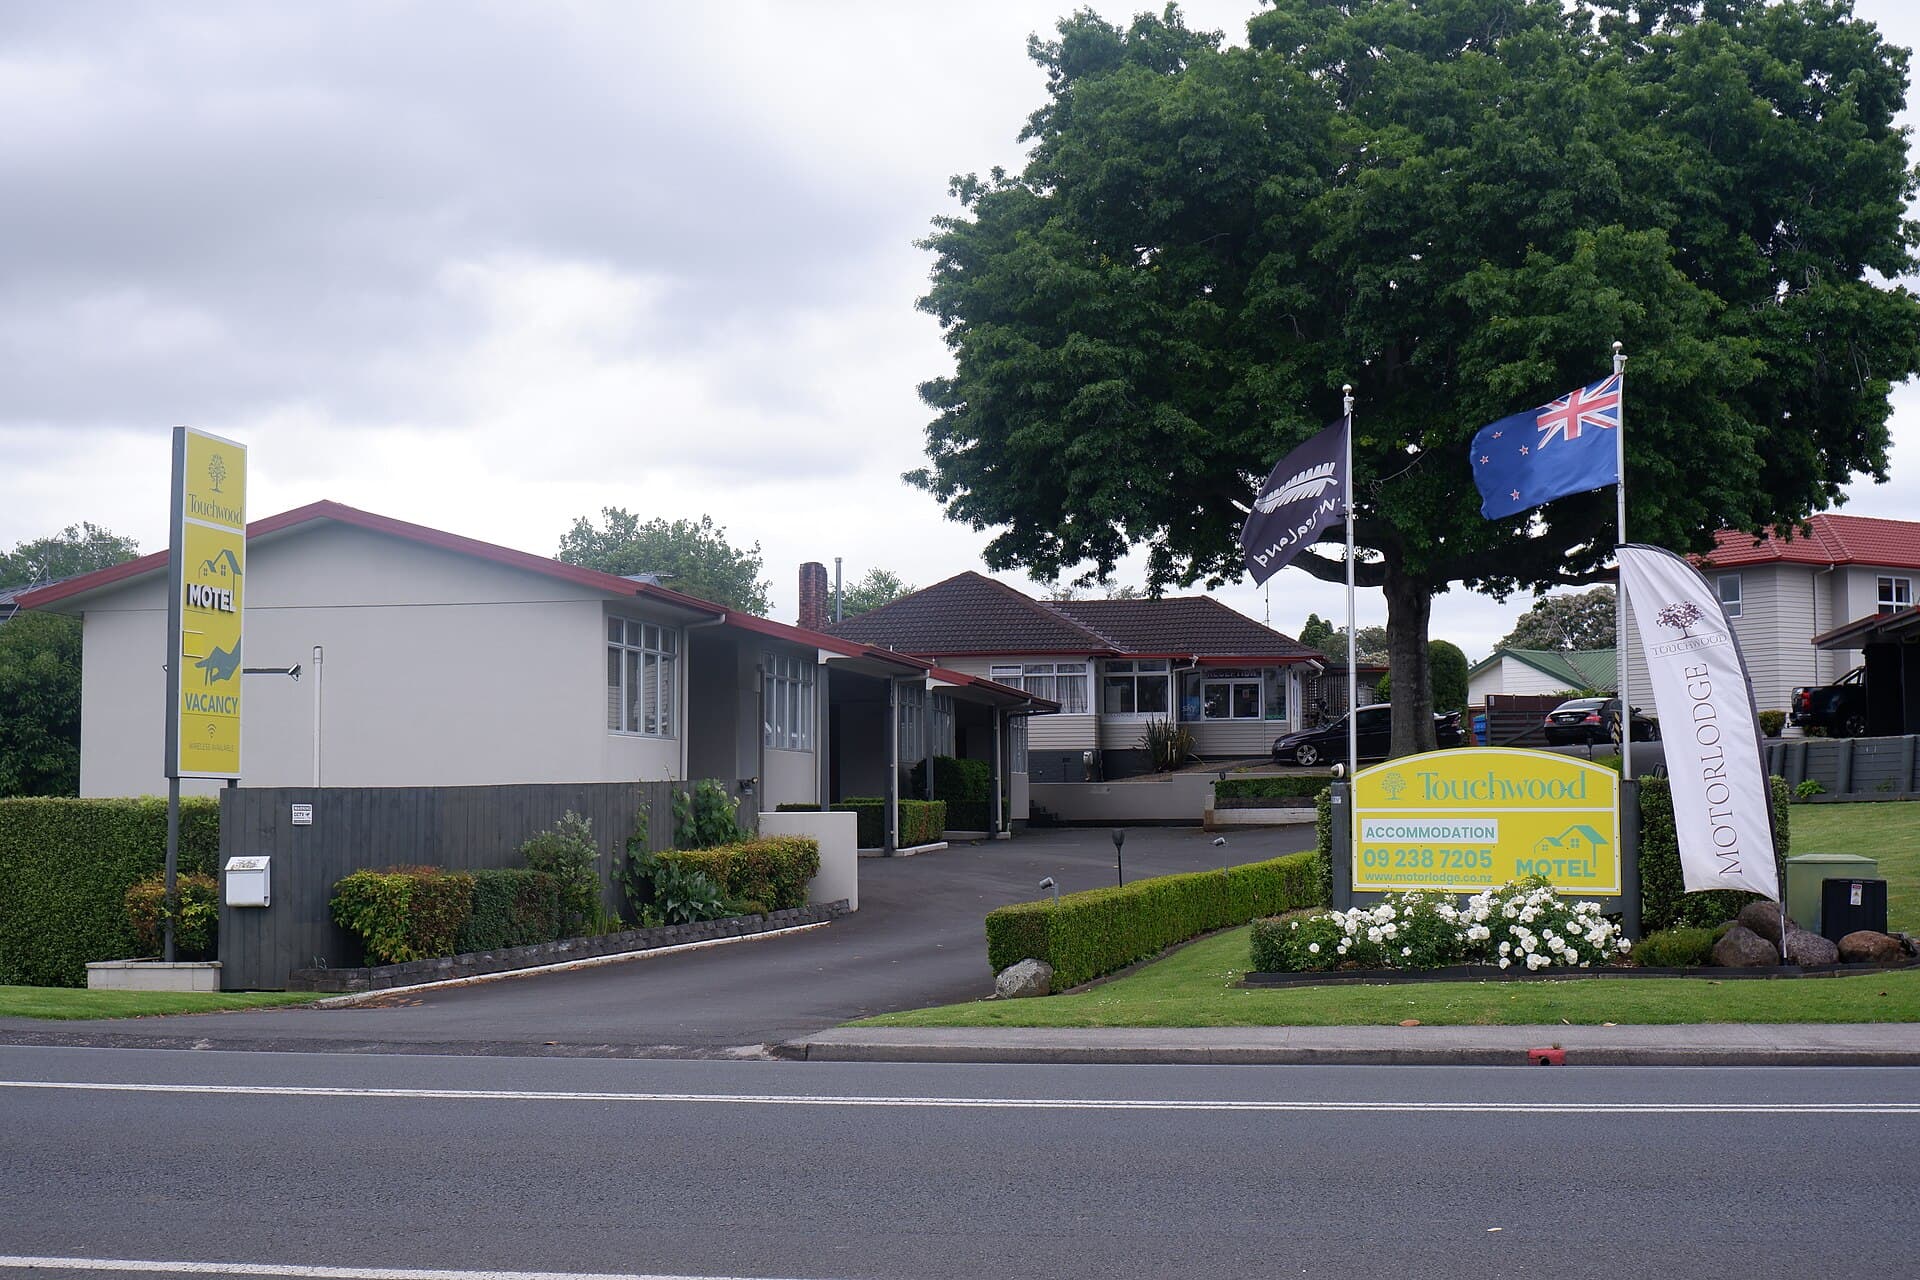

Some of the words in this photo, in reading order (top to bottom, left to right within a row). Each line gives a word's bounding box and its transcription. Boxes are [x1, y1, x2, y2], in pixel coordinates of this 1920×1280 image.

[188, 493, 242, 525] Touchwood
[186, 583, 237, 613] MOTEL
[1650, 633, 1728, 656] TOUCHWOOD
[184, 692, 239, 714] VACANCY
[1684, 662, 1743, 877] MOTORLODGE
[1416, 770, 1587, 801] Touchwood
[1365, 826, 1495, 839] ACCOMMODATION
[1363, 848, 1389, 868] 09
[1394, 848, 1434, 868] 238
[1439, 848, 1493, 869] 7205
[1516, 858, 1597, 877] MOTEL
[1365, 872, 1493, 885] www.motorlodge.co.nz
